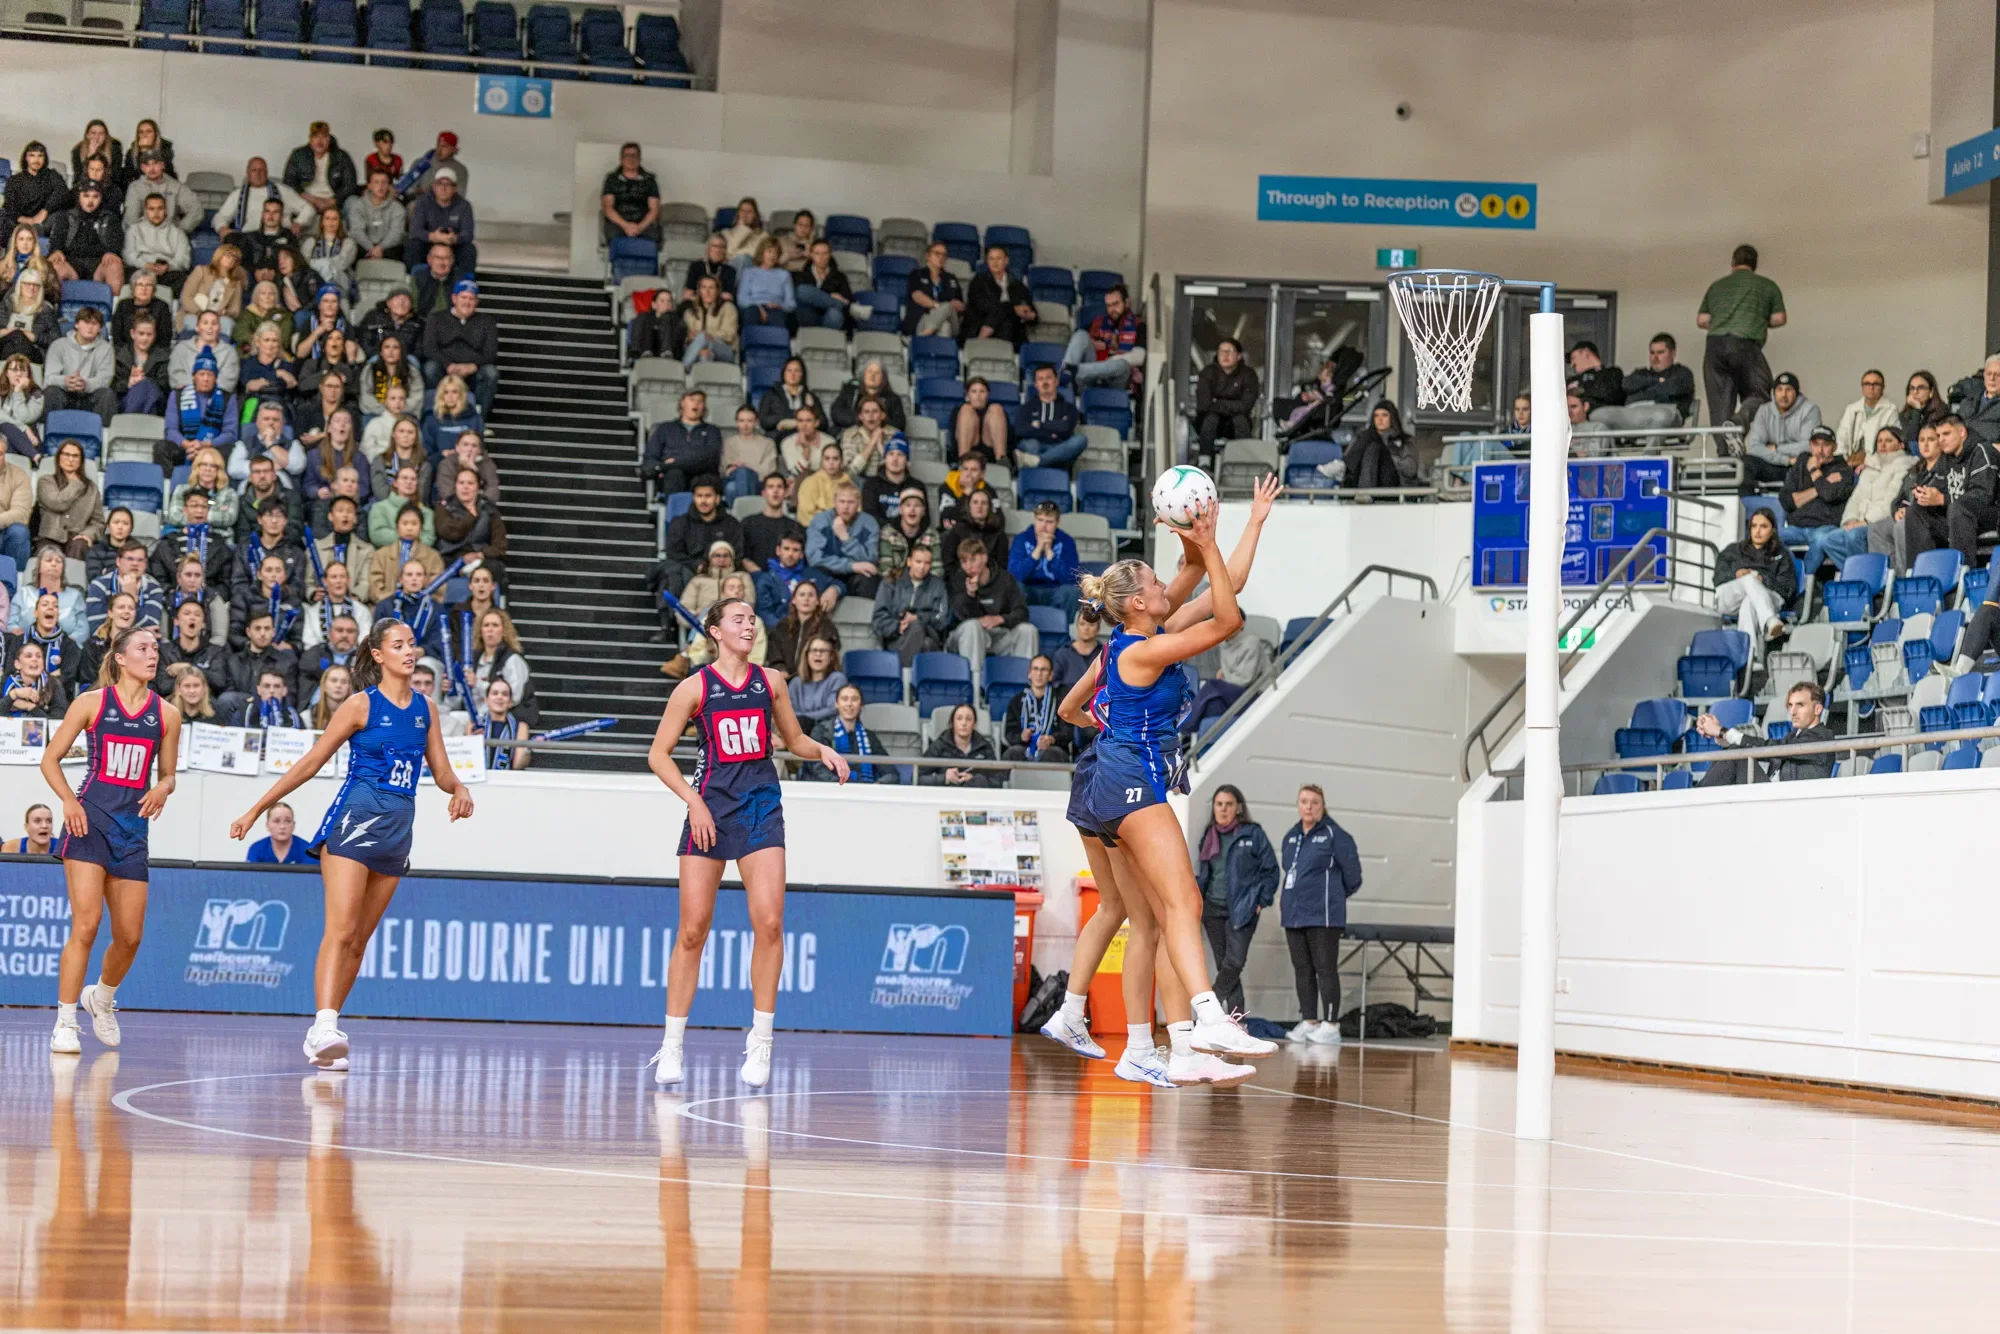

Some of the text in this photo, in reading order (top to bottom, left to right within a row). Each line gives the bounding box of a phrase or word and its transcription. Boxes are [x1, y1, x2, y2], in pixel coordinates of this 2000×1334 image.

[1266, 190, 1450, 211] Through to Reception
[718, 716, 761, 755] GK
[106, 741, 147, 780] WD
[1126, 788, 1142, 803] 27
[569, 925, 624, 986] UNI
[641, 927, 817, 993] LIHTNNG
